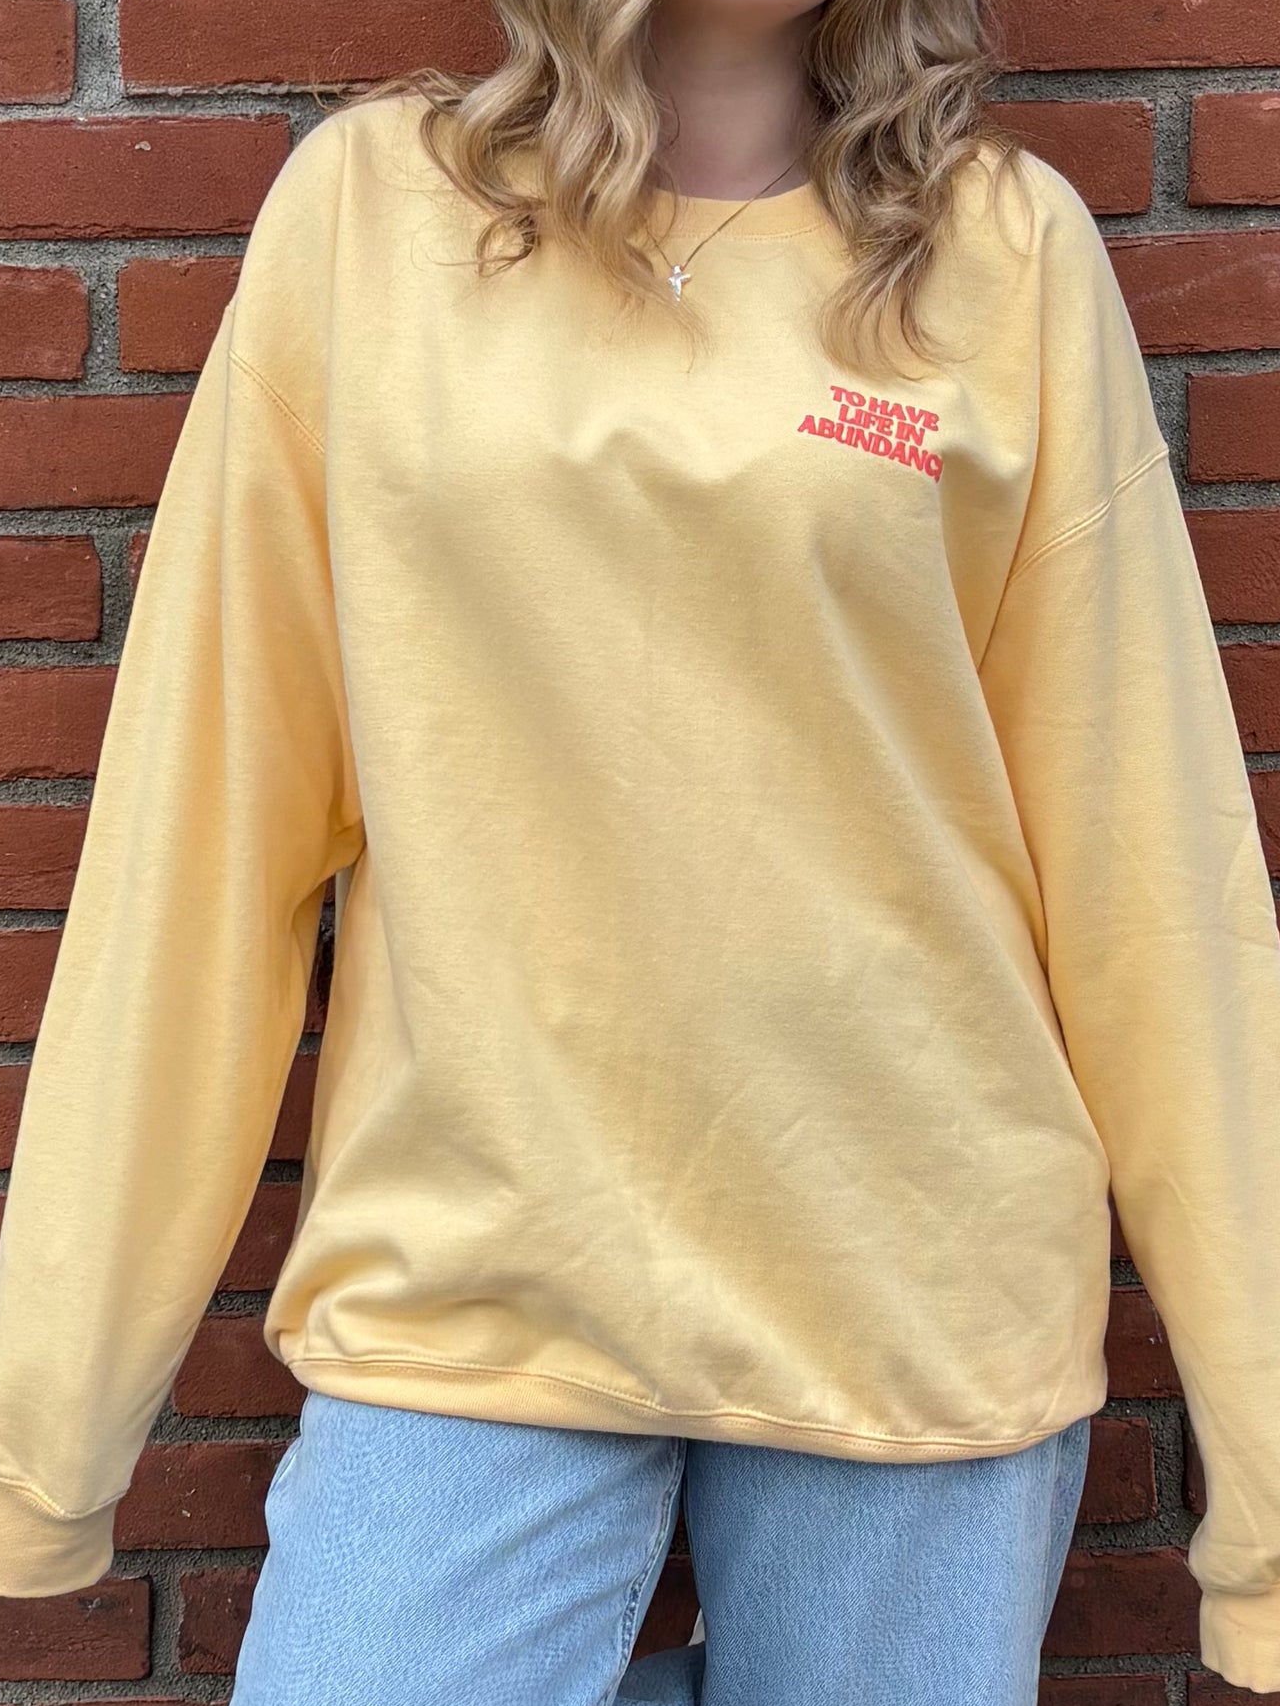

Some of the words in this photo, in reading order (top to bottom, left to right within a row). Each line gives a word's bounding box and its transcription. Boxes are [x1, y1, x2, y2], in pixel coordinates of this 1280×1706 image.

[830, 385, 865, 407] TO
[869, 396, 939, 432] HAVE
[838, 404, 893, 436] LIFE
[895, 421, 926, 446] IN
[797, 414, 944, 484] ABUNDANC
